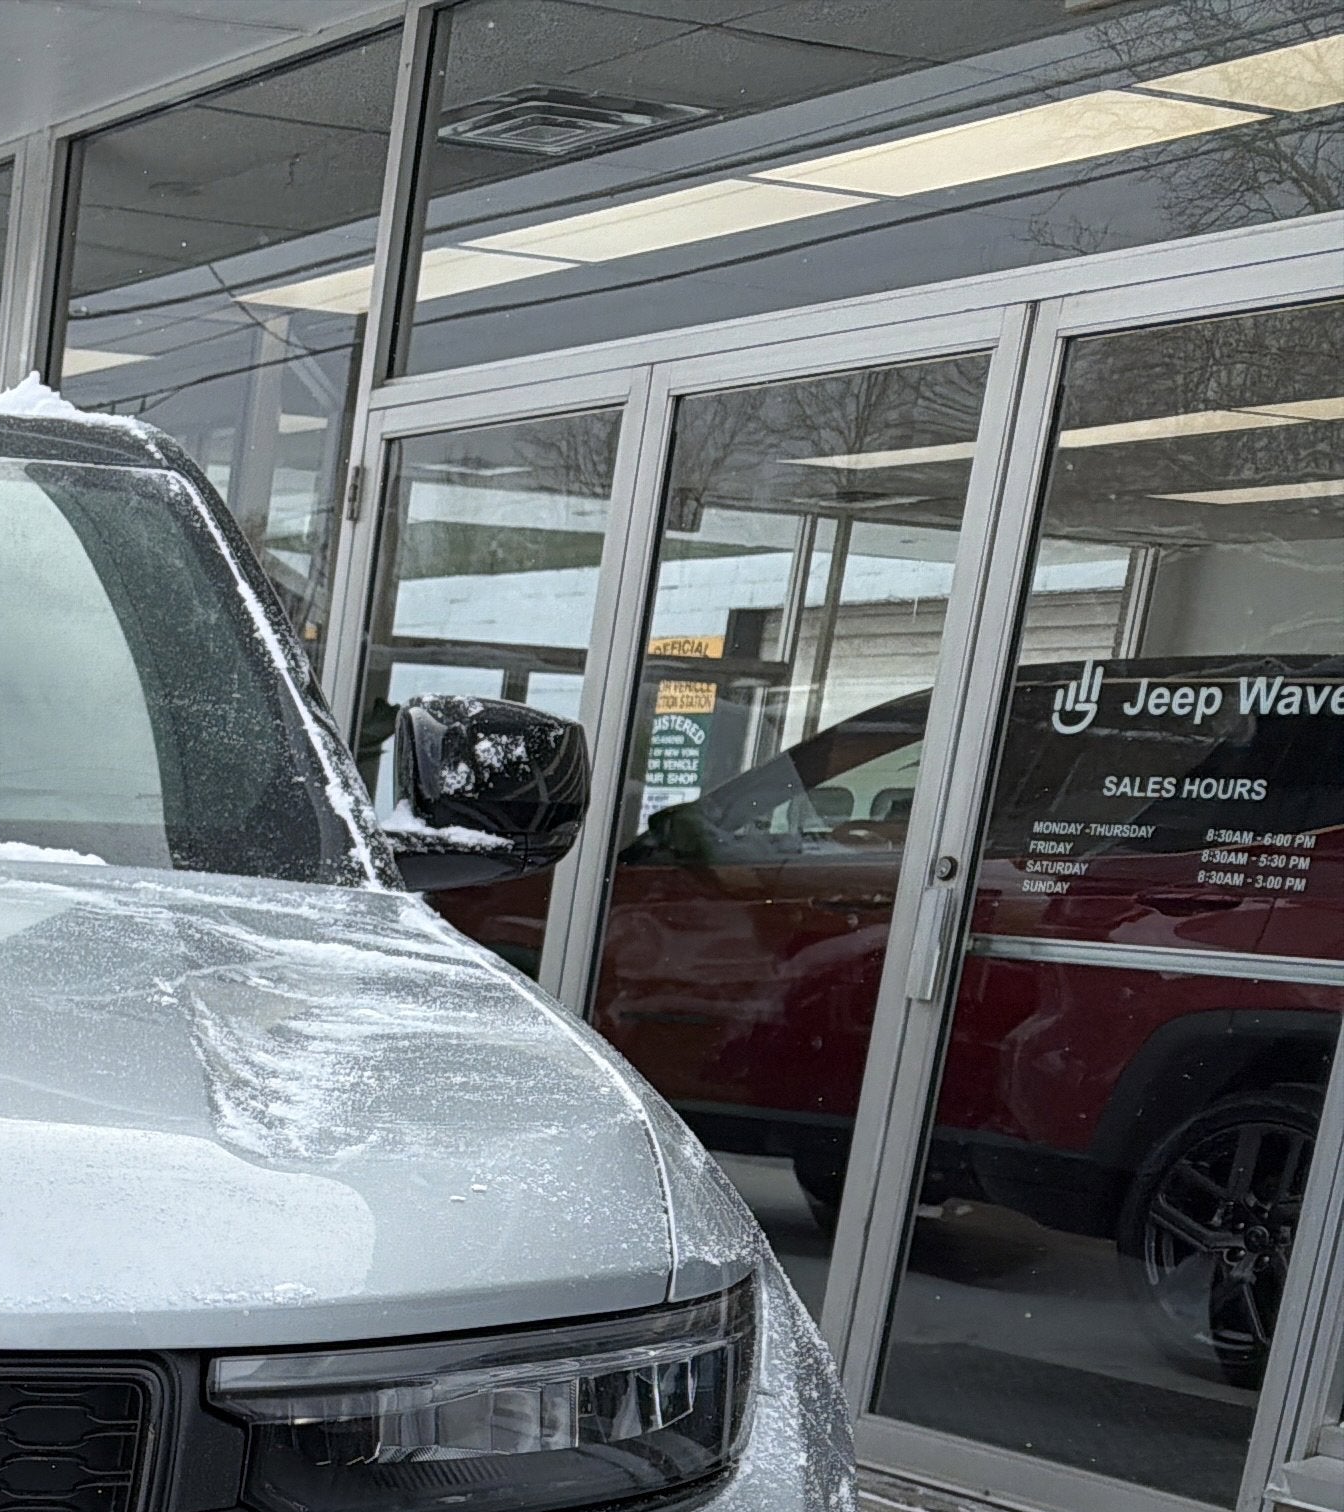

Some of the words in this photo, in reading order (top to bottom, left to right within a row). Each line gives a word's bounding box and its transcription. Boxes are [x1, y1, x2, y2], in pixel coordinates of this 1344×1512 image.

[1123, 678, 1222, 725] Jeep
[1102, 776, 1177, 799] SALES
[1182, 777, 1268, 801] HOURS
[1028, 840, 1074, 855] FRIDAY
[1205, 828, 1254, 845] 8:30AM
[1263, 833, 1292, 847] 6:00
[1293, 834, 1316, 849] PM
[1025, 859, 1089, 876] SATURDAY
[1201, 849, 1249, 865] 8:30AM
[1258, 853, 1287, 868] 5:30
[1288, 856, 1311, 870] PM
[1022, 879, 1071, 894] SUNDAY
[1197, 870, 1245, 887] 8:30AM
[1284, 876, 1307, 892] PM
